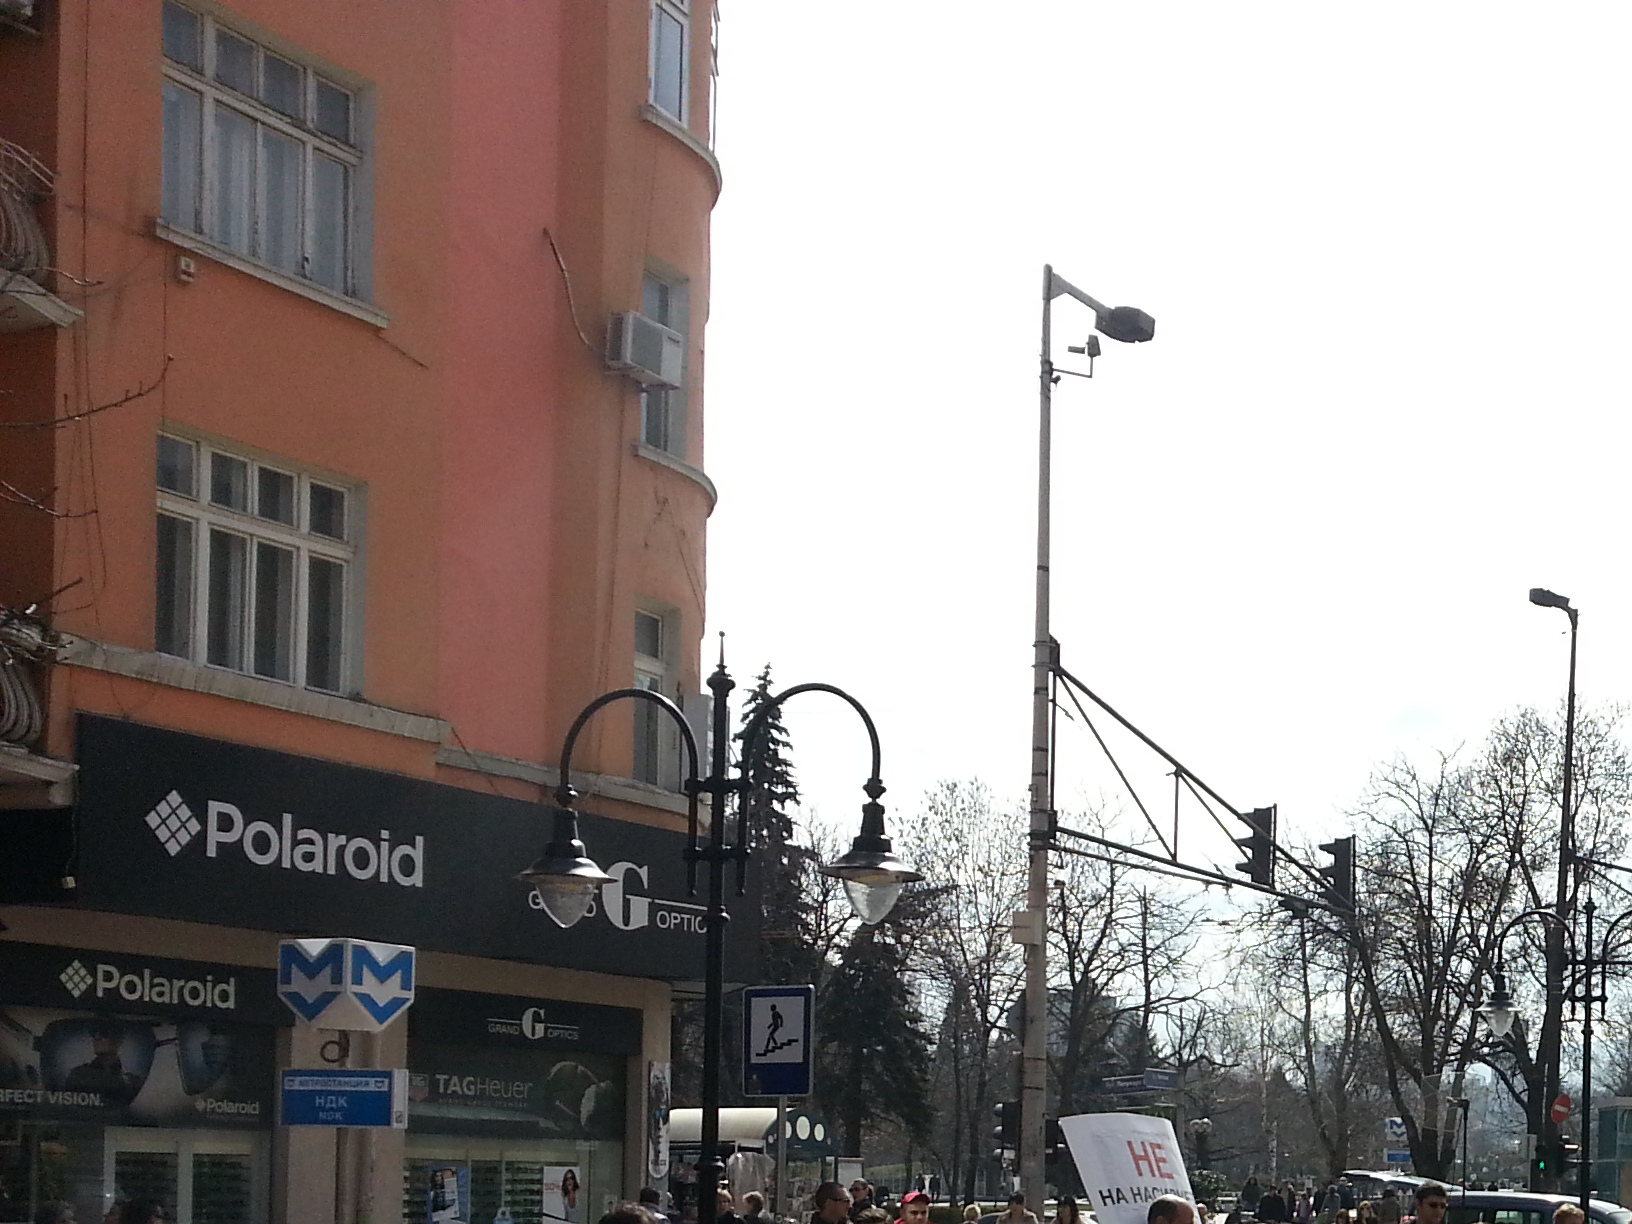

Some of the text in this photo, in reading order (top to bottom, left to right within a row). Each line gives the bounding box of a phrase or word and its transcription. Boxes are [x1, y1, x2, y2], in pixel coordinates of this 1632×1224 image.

[206, 800, 424, 888] Polaroid
[656, 910, 708, 934] OPTIC
[96, 963, 236, 1010] Polaroid
[488, 1023, 520, 1035] GRAND
[547, 1028, 579, 1040] OPTICS
[49, 1090, 104, 1107] VISION.
[206, 1098, 260, 1115] Polaroid
[315, 1095, 348, 1109] НДК
[1127, 1140, 1175, 1180] НЕ
[1098, 1187, 1129, 1207] НА
